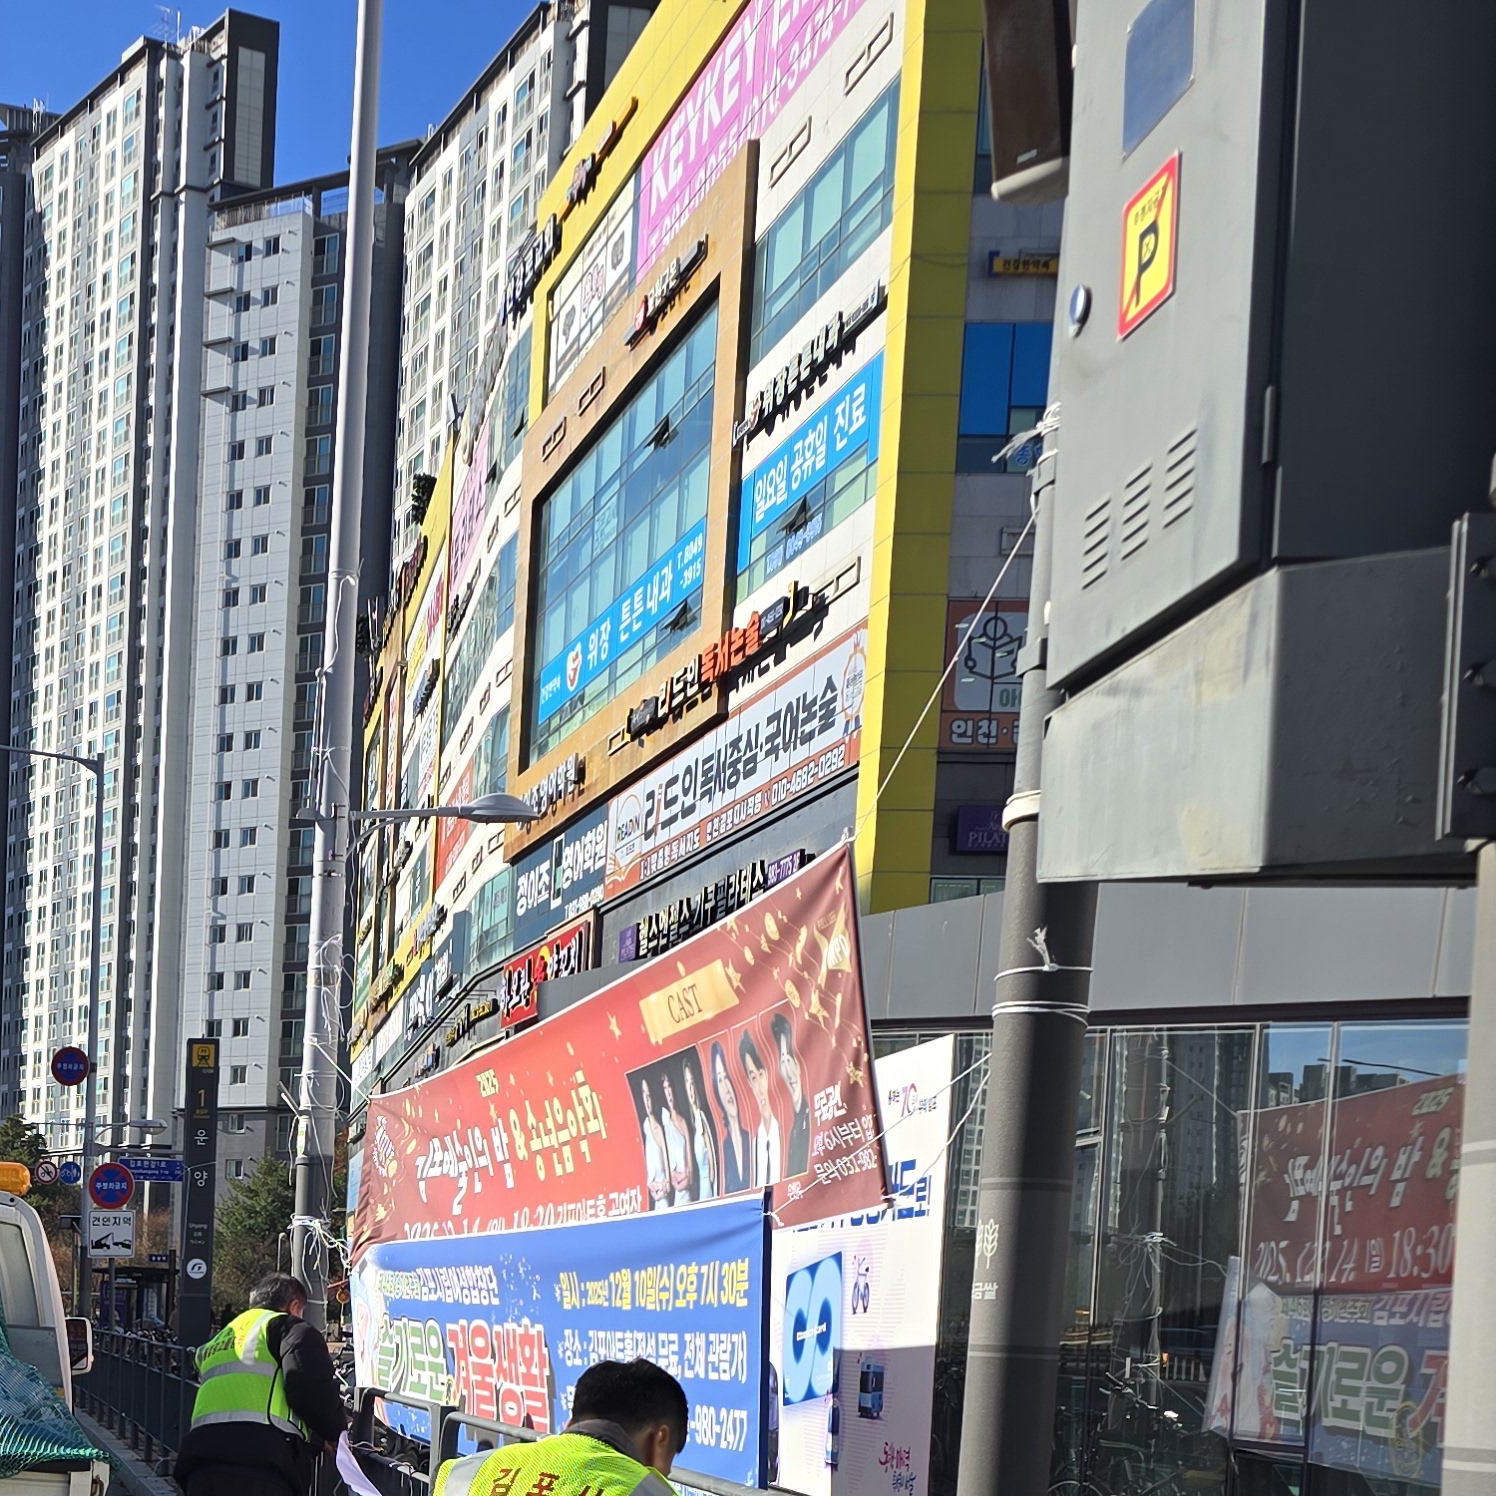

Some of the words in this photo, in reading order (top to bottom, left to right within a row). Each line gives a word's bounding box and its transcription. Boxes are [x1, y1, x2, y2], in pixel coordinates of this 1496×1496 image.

[762, 311, 841, 416] 위장튼튼내과
[755, 454, 788, 524] 일요일
[790, 414, 828, 491] 공휴일
[833, 383, 867, 452] 진료
[677, 532, 703, 570] T.8049
[587, 617, 611, 670] 위장
[619, 586, 645, 643] 튼튼
[646, 560, 673, 615] 내과
[516, 860, 551, 917] 정이조
[562, 820, 608, 890] 영어학원
[667, 983, 704, 1024] CAST
[197, 1089, 206, 1107] 1
[475, 1068, 500, 1099] 2025
[415, 1126, 495, 1216] 김포예술인의
[491, 1117, 516, 1189] 밤
[509, 1108, 529, 1162] &
[526, 1070, 608, 1182] 송년음악회
[91, 1215, 132, 1227] 견인지역
[416, 1265, 501, 1307] 김포시립여성합창단
[559, 1271, 580, 1310] 일시
[609, 1269, 632, 1311] 12월
[634, 1263, 675, 1312] 10일(수)
[675, 1261, 699, 1310] 오후
[700, 1260, 720, 1308] 7시
[720, 1258, 750, 1308] 30분
[377, 1313, 448, 1404] 슬기로운
[446, 1318, 551, 1435] 겨울생활
[563, 1329, 582, 1368] 장소
[683, 1331, 706, 1380] 전체
[707, 1330, 748, 1385] 관람가)
